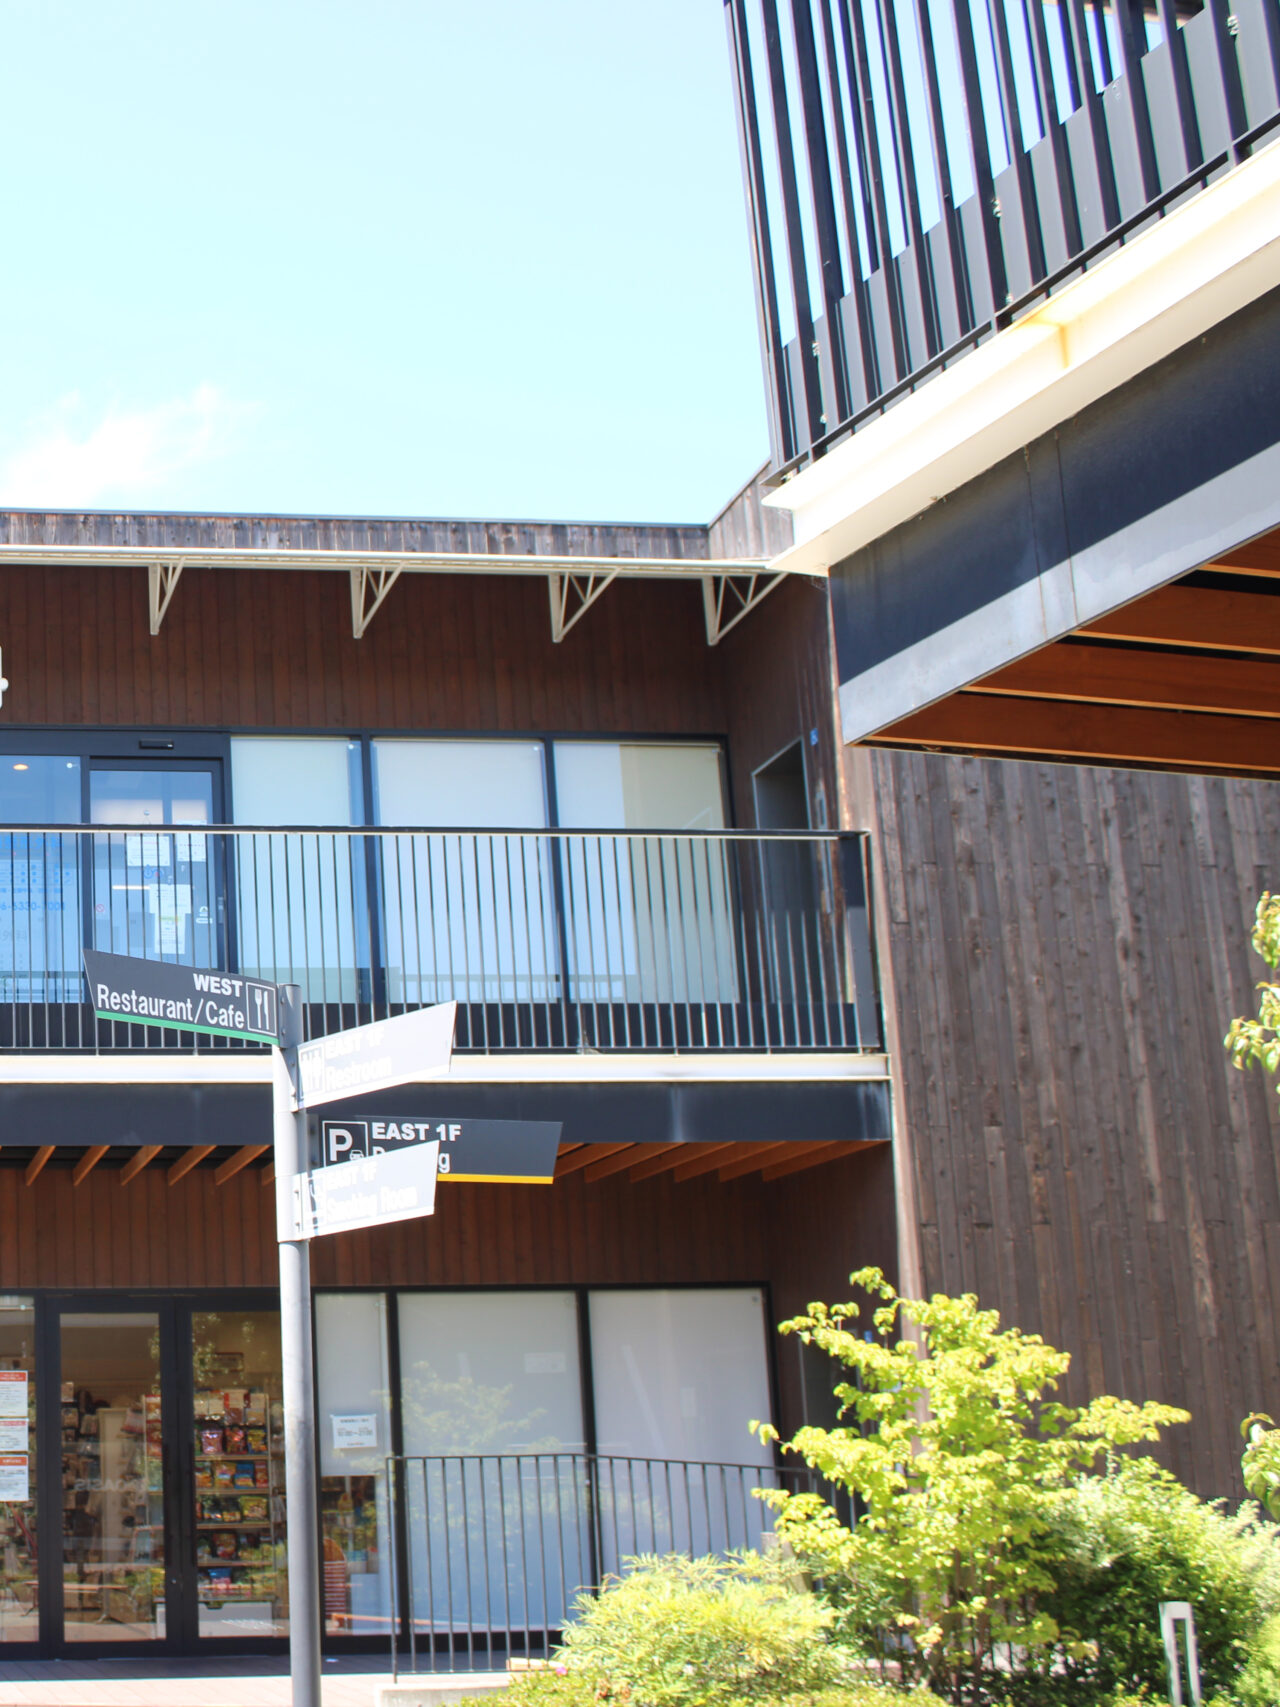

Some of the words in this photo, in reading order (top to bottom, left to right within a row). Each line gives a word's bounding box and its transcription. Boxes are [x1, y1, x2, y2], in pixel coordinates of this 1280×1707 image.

[192, 973, 243, 997] WEST
[96, 984, 245, 1029] Restaurant/Cafe
[326, 1032, 362, 1058] EAST
[367, 1026, 384, 1047] 1F
[326, 1056, 393, 1091] Restroom
[329, 1128, 353, 1161] P
[372, 1122, 429, 1140] EAST
[436, 1123, 461, 1141] 1F
[326, 1166, 360, 1190] EAST
